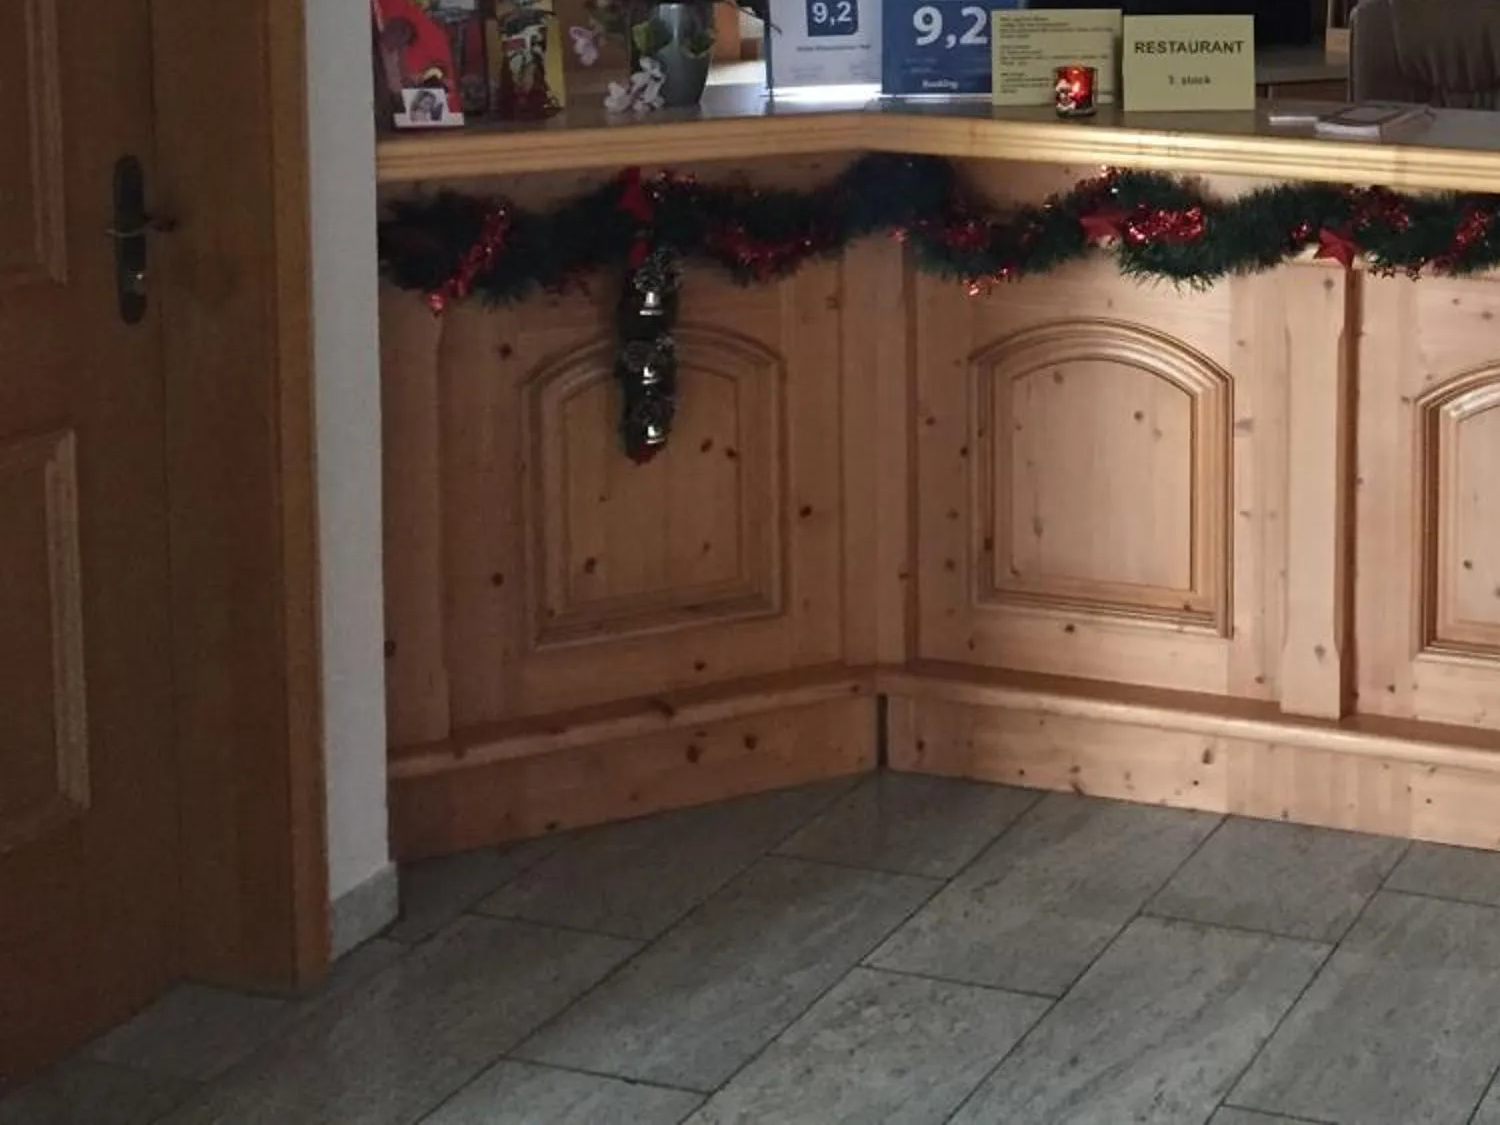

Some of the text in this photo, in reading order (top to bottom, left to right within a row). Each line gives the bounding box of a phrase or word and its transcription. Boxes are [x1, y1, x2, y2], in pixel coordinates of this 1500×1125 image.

[812, 1, 853, 26] 9,2
[912, 5, 989, 49] 9,2
[1133, 40, 1246, 55] RESTAURANT
